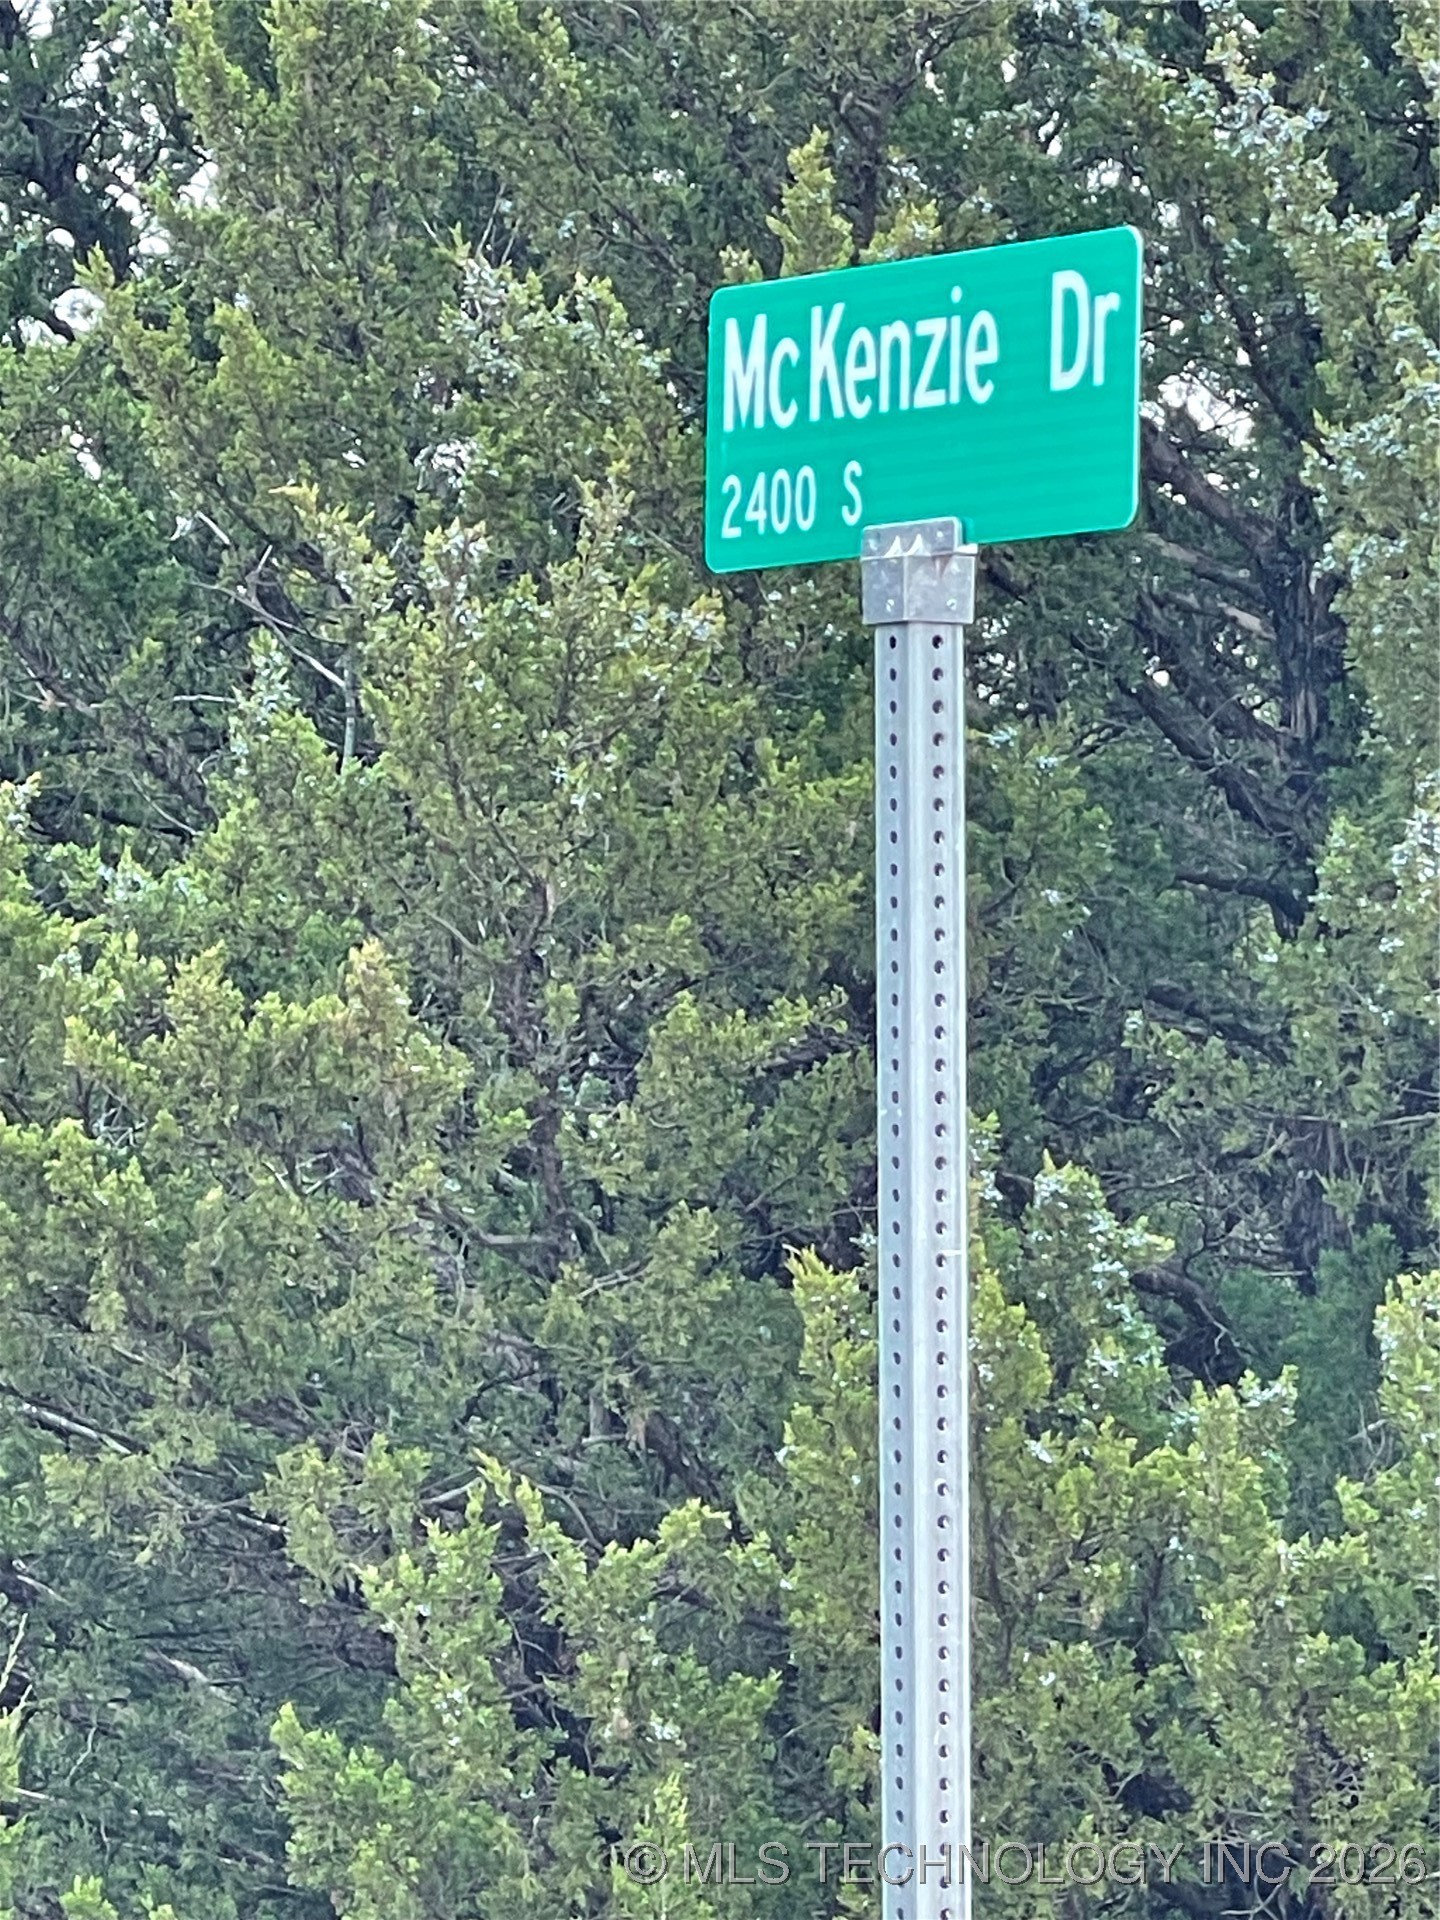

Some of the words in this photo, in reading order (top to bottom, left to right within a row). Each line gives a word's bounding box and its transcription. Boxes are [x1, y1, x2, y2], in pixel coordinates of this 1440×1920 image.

[722, 286, 999, 432] McKenzie
[1050, 269, 1121, 392] Dr
[721, 465, 817, 539] 2400
[841, 460, 863, 526] S
